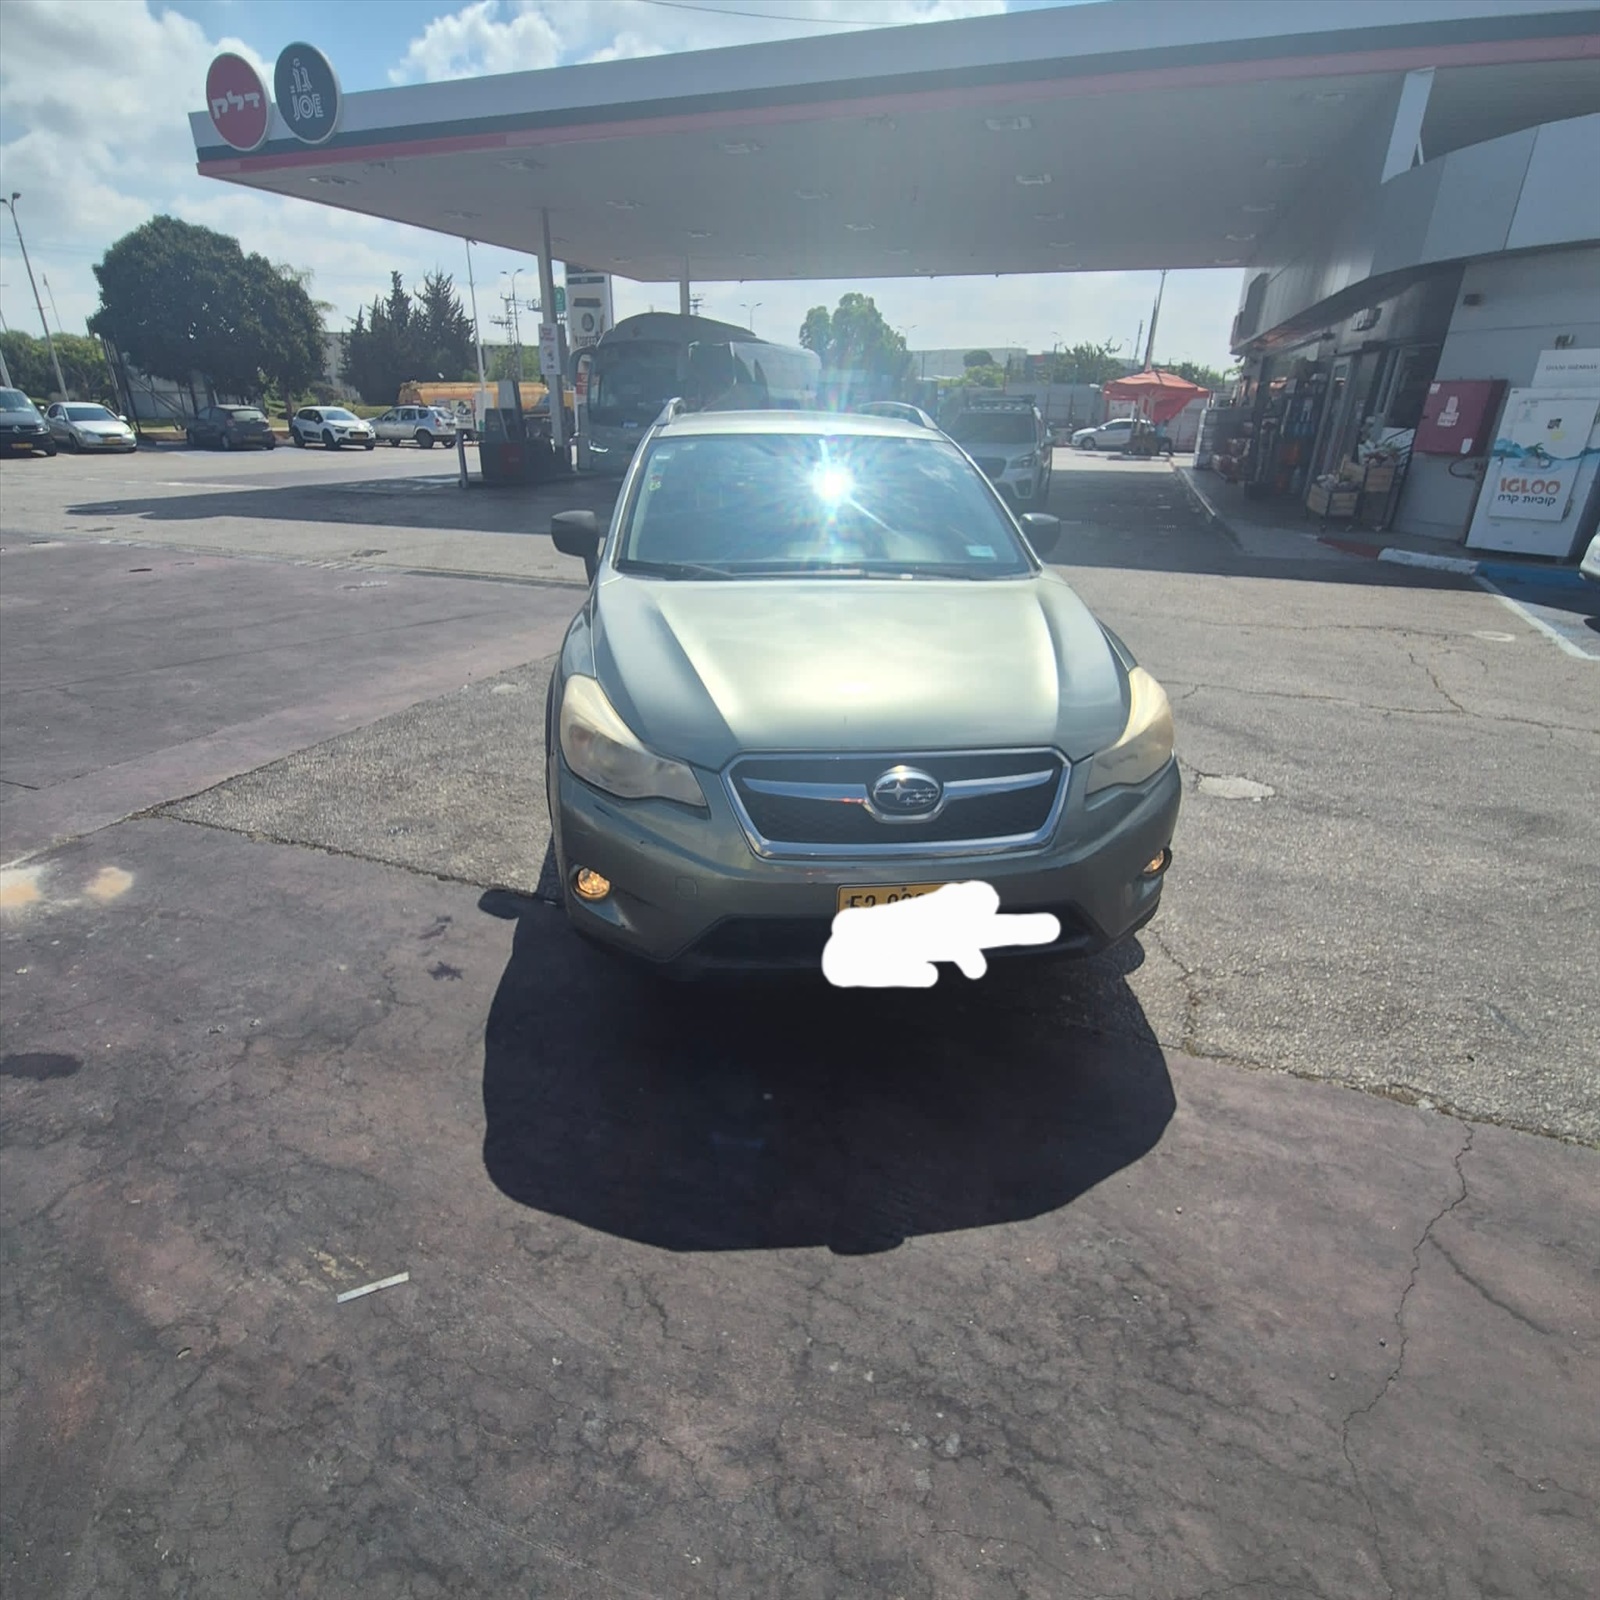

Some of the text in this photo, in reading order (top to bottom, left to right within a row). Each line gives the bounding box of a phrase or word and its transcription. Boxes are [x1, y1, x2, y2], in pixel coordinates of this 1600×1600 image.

[211, 90, 260, 119] דלק
[292, 94, 324, 121] JOE
[1500, 478, 1561, 495] IGLOO
